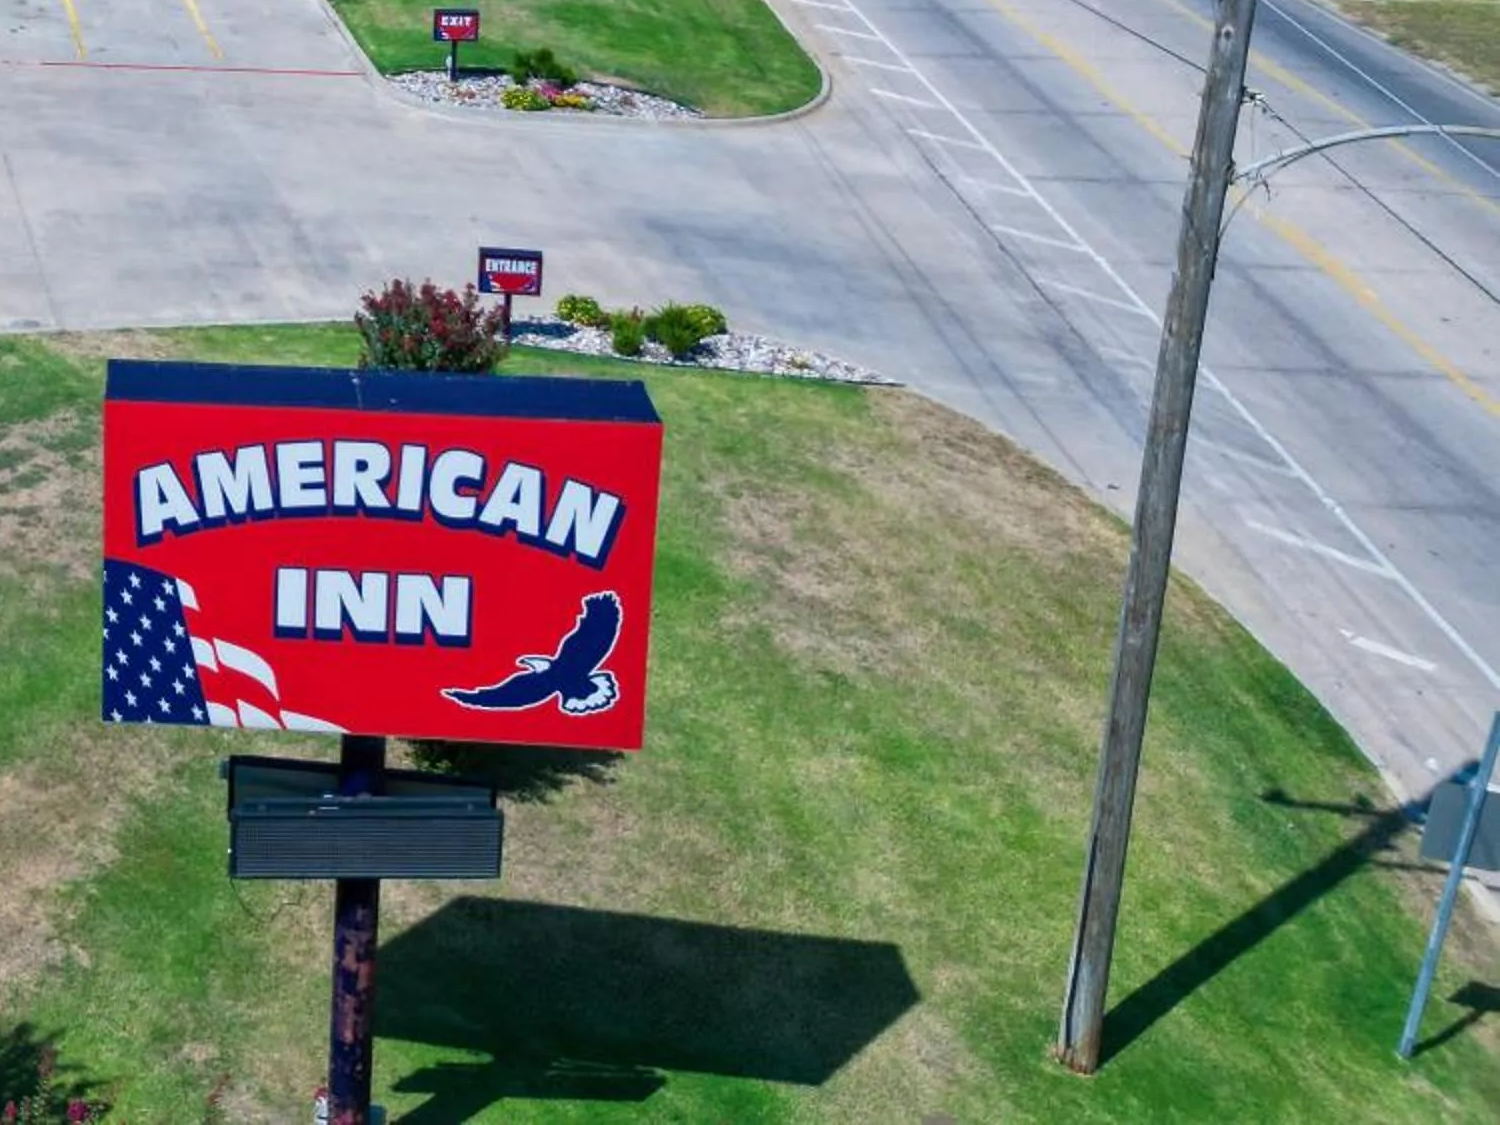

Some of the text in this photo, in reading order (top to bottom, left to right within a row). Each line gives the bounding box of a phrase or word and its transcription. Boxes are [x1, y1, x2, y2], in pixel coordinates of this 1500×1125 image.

[440, 15, 473, 28] EXIT
[135, 439, 626, 569] AMERICAN
[274, 567, 473, 647] INN
